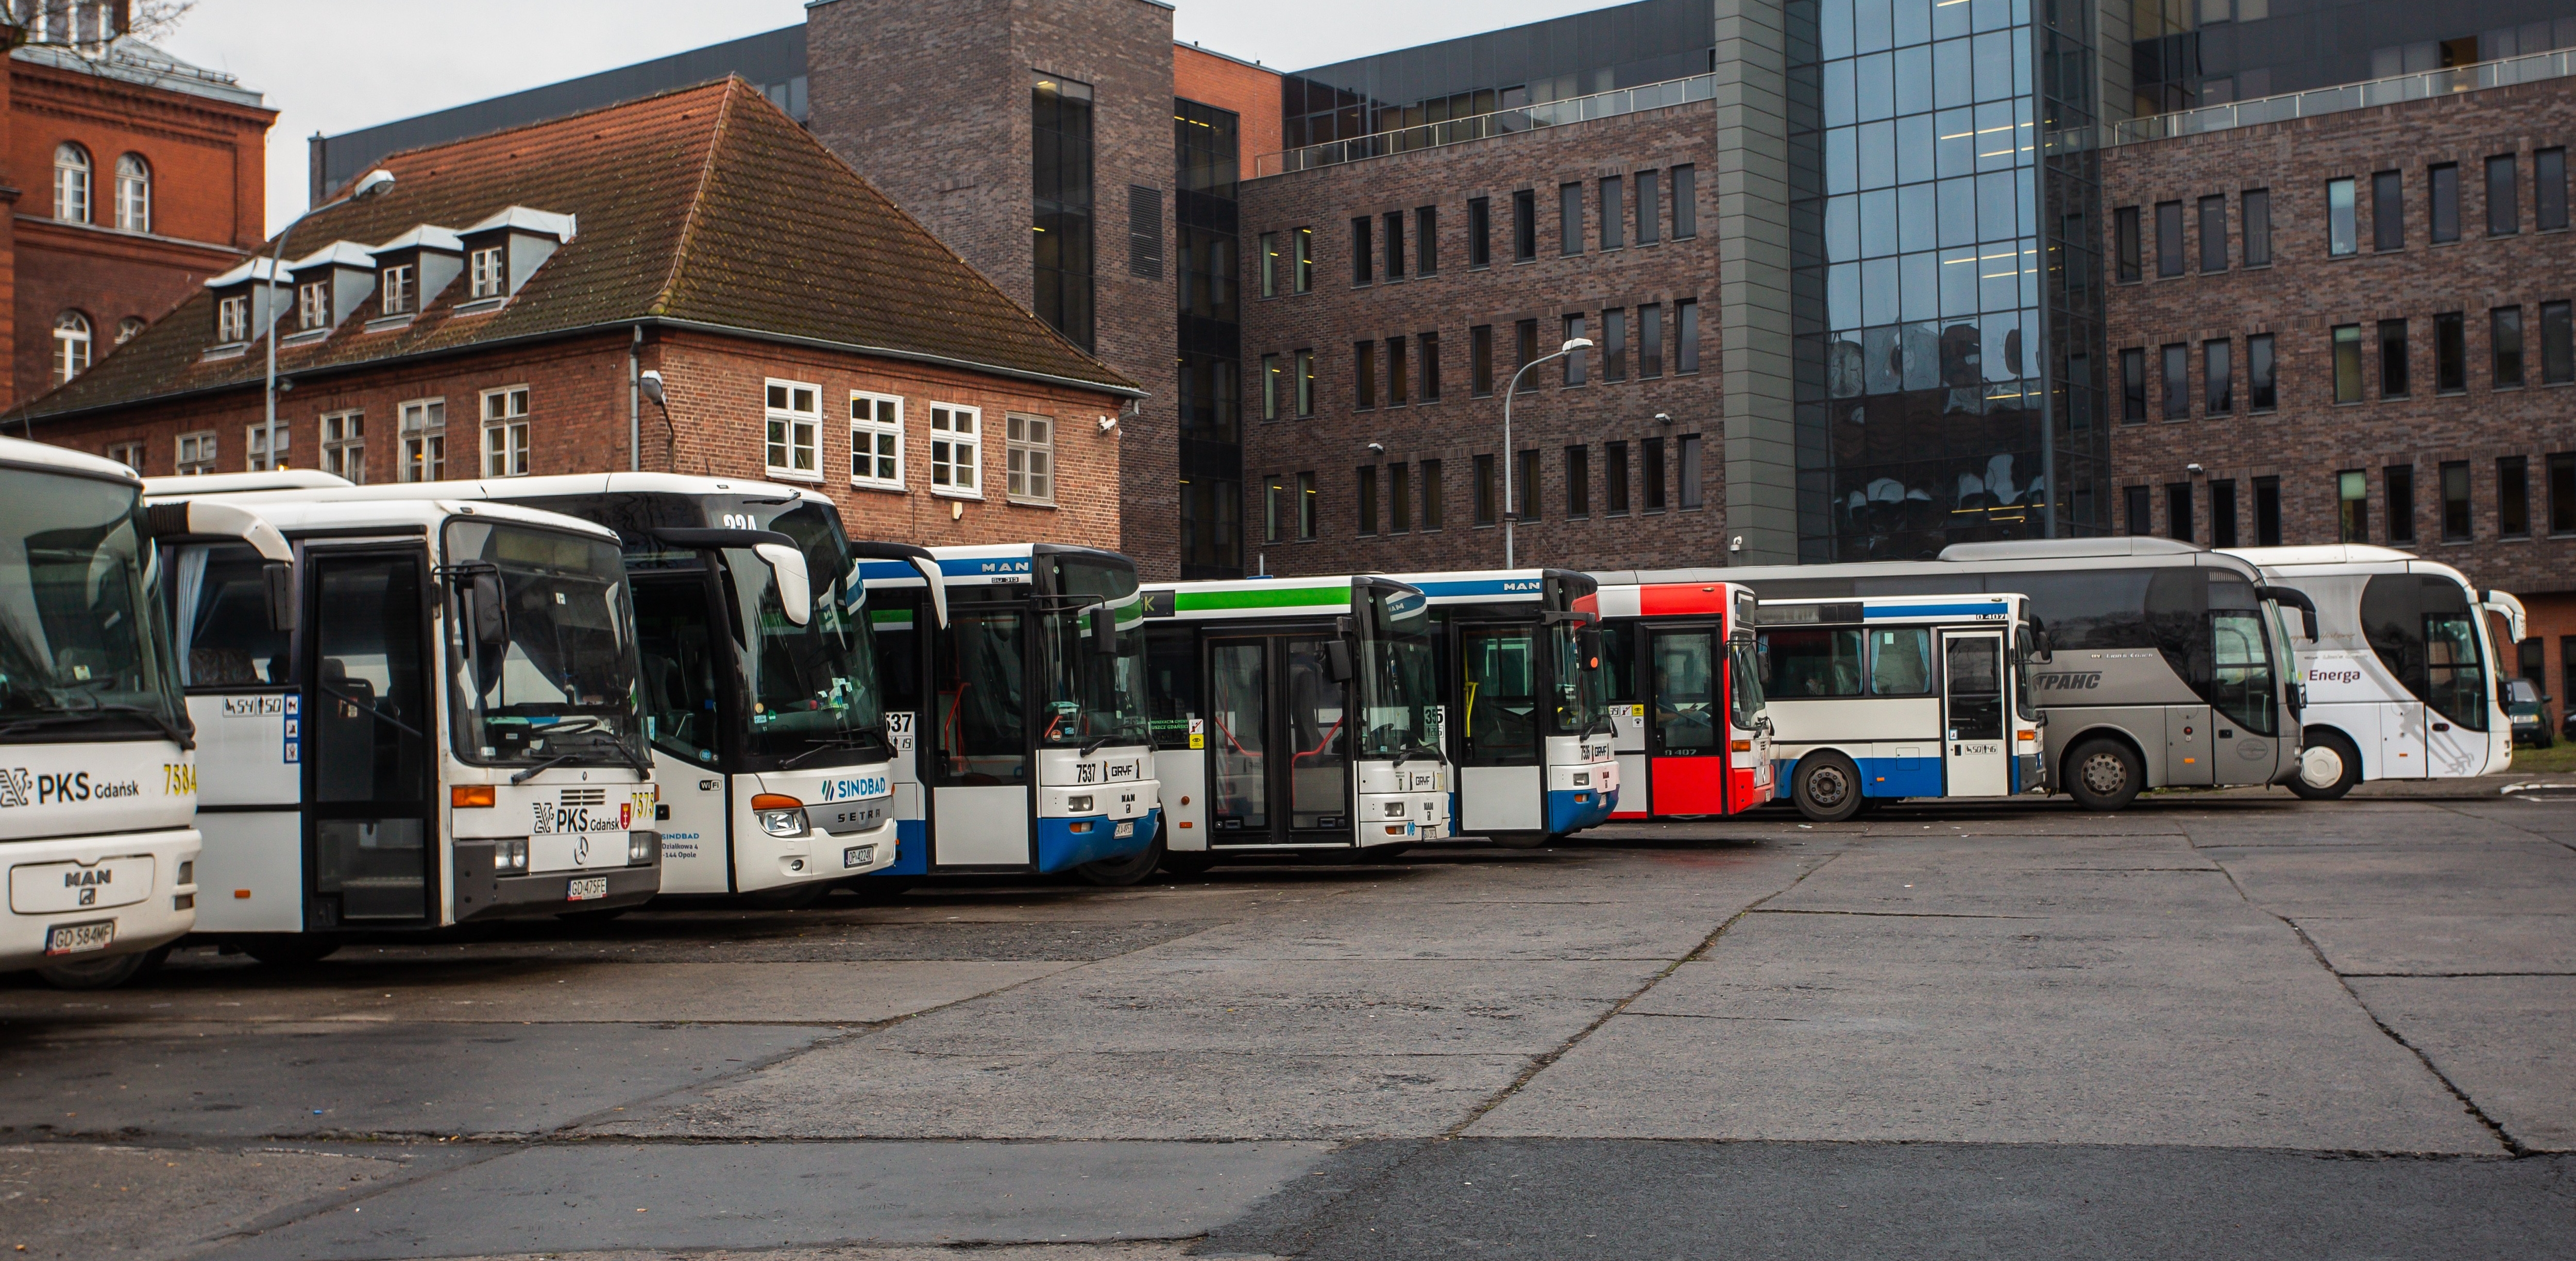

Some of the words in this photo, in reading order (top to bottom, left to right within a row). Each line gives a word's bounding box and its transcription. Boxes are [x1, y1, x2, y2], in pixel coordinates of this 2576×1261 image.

[982, 563, 1028, 572] MAN
[1504, 582, 1540, 590] MAN
[1141, 596, 1154, 611] K
[2309, 670, 2360, 684] Energa
[238, 699, 253, 714] 54
[265, 698, 281, 713] 50
[1076, 763, 1096, 782] 7537
[1112, 765, 1132, 776] GRYF
[164, 763, 197, 796] 7584
[1416, 776, 1430, 786] GRYF
[38, 771, 91, 805] PKS
[94, 780, 139, 799] Gdańsk
[838, 777, 885, 798] SINDBAD
[632, 792, 654, 819] 7575
[1122, 794, 1135, 803] MAN
[557, 808, 588, 832] PKS
[590, 817, 619, 831] Gdańsk
[838, 809, 880, 823] SETRA
[65, 869, 111, 887] MAN
[572, 881, 582, 895] GD
[585, 879, 605, 893] 475FE
[56, 929, 73, 947] GD
[77, 925, 111, 945] 584MF
